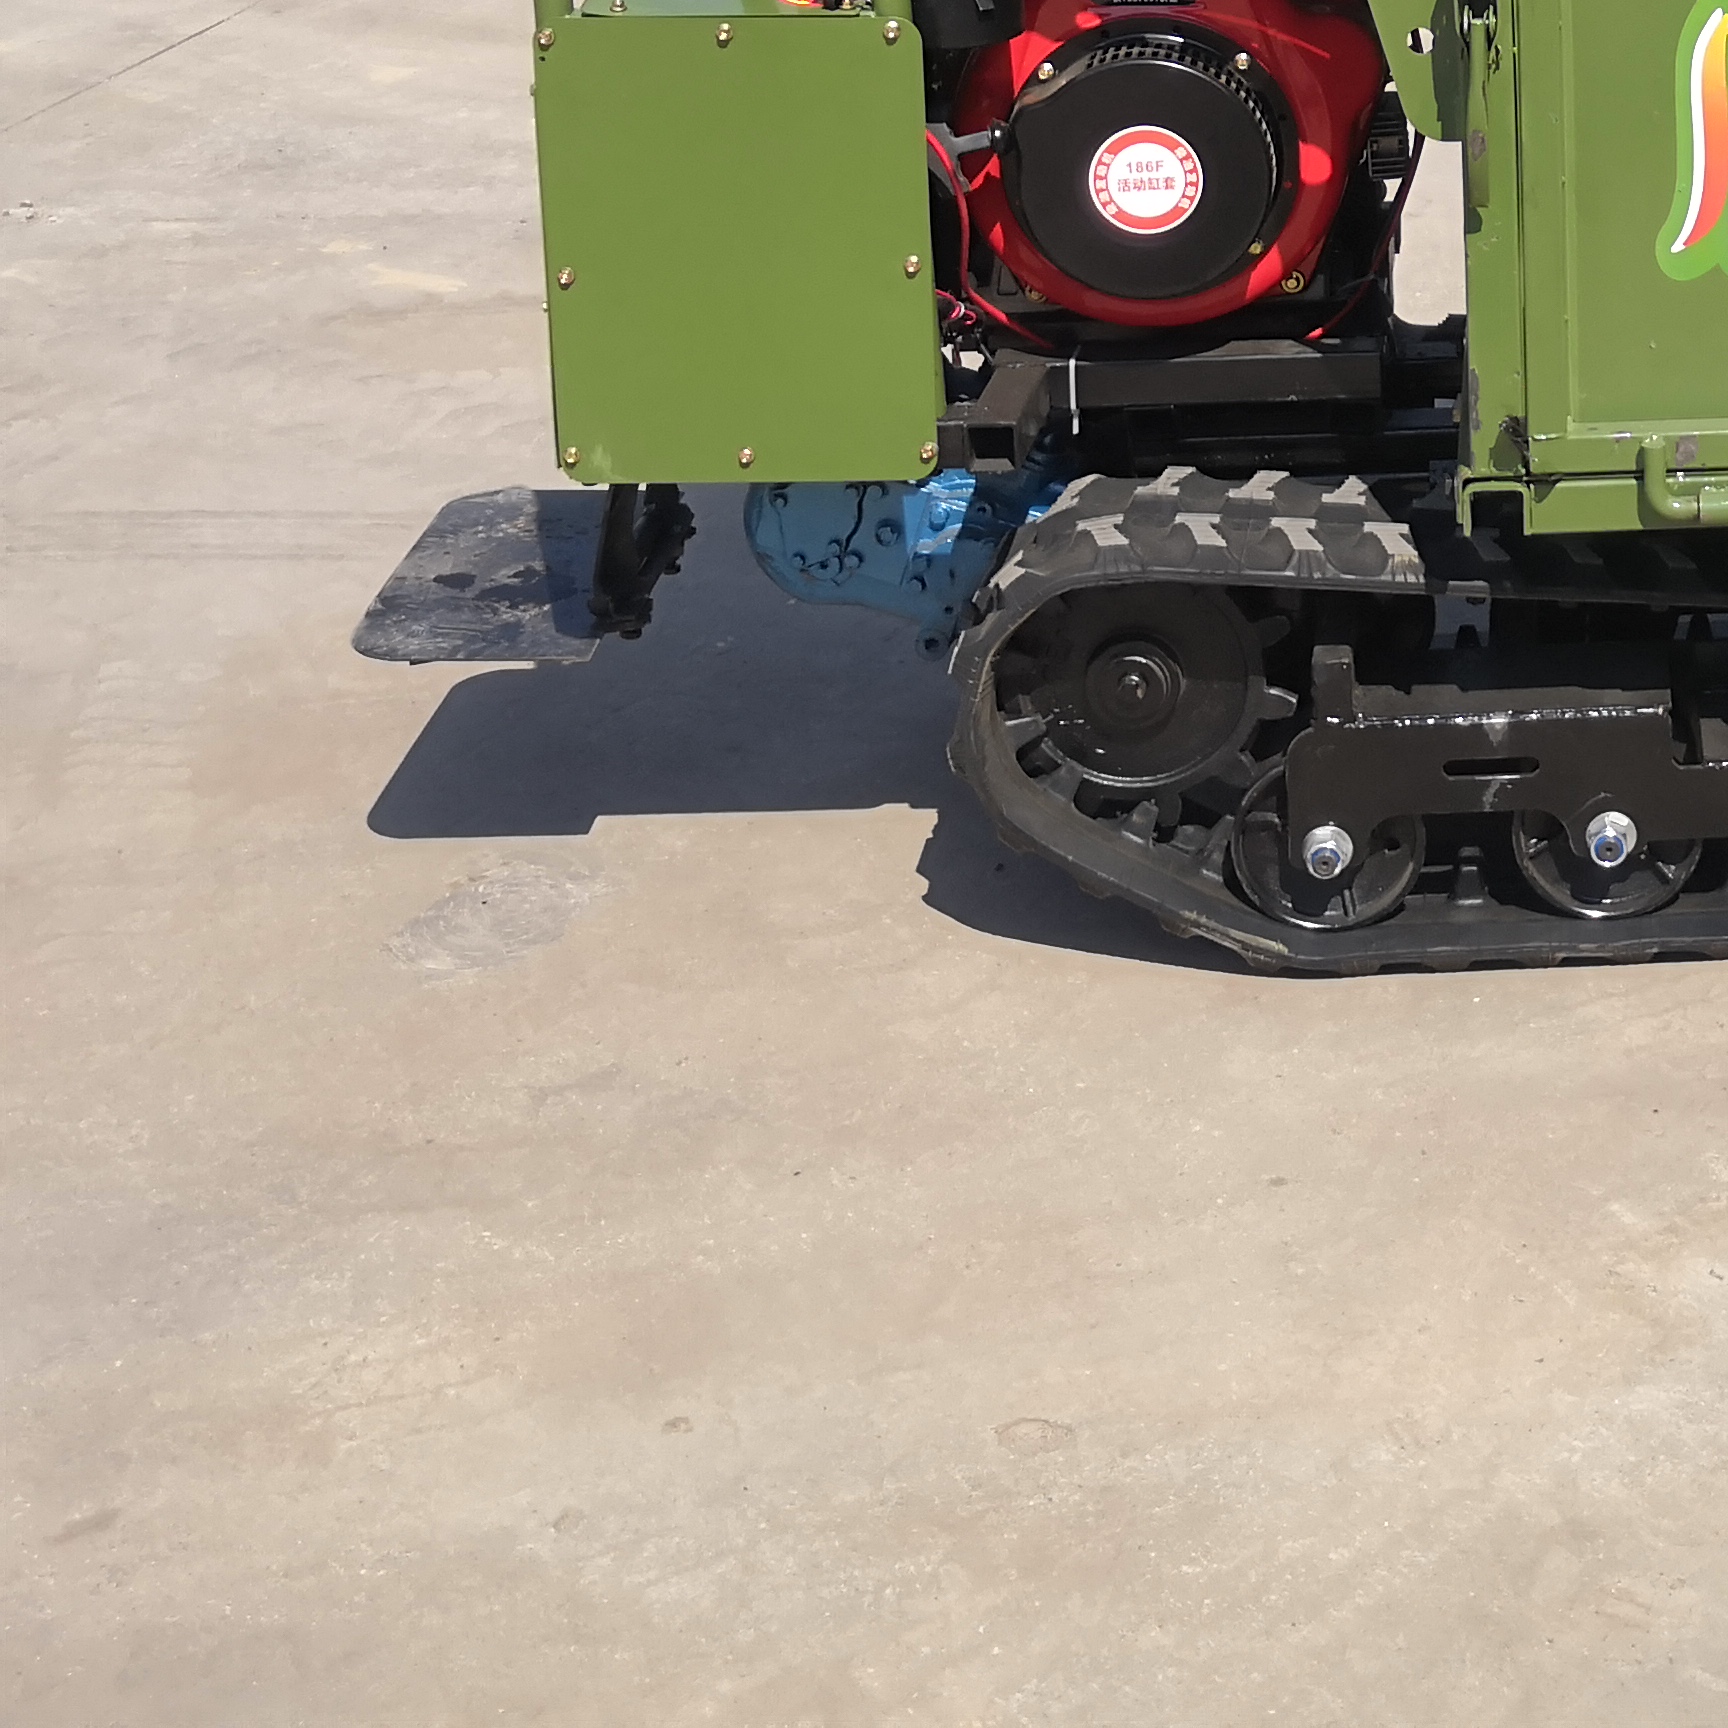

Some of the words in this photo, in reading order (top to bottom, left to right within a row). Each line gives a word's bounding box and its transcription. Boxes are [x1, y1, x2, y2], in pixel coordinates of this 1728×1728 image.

[1125, 159, 1165, 174] 186F
[1117, 175, 1176, 193] 活动缸套
